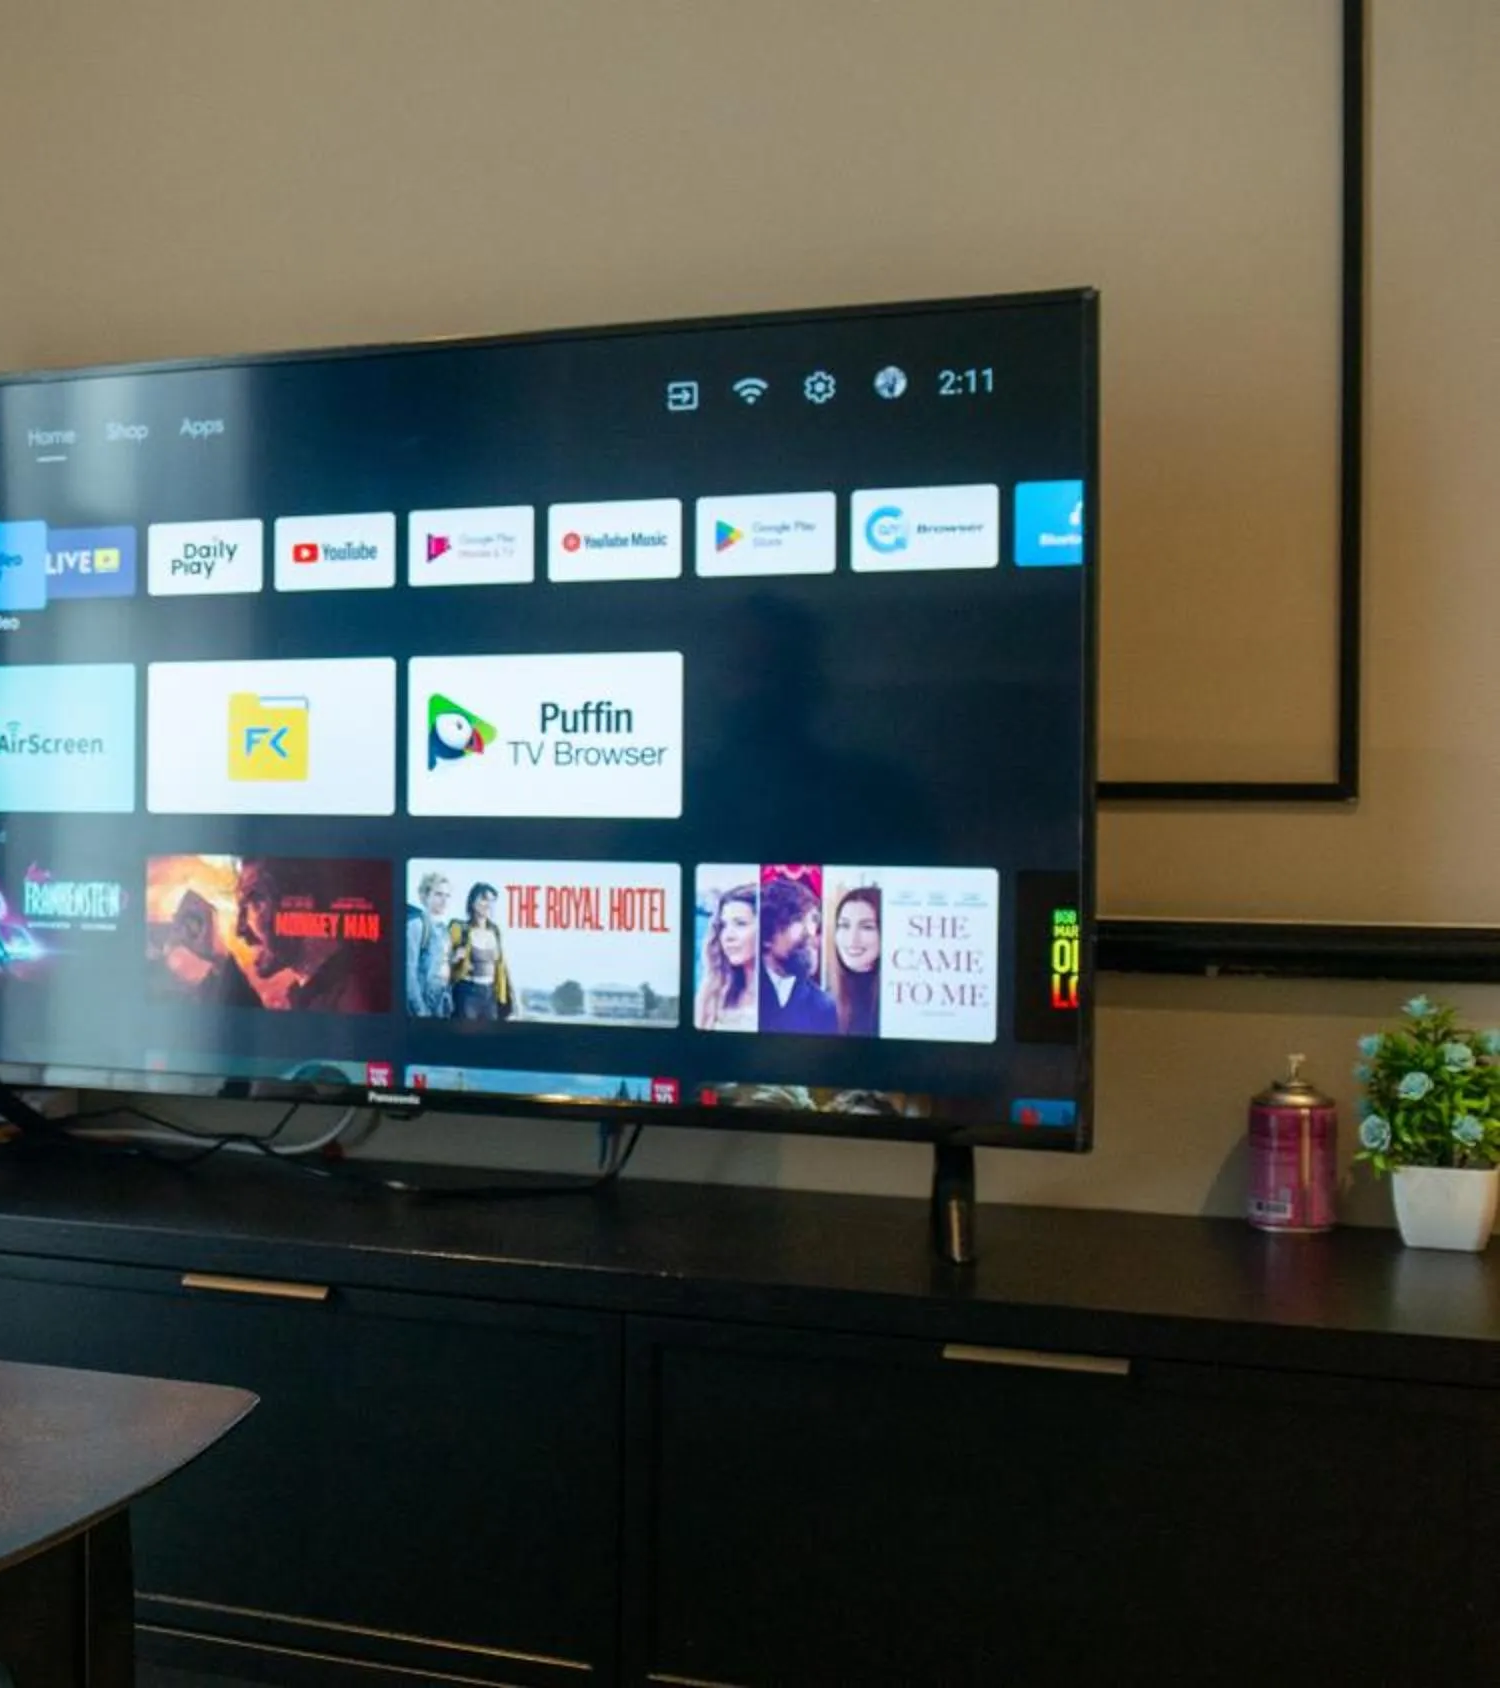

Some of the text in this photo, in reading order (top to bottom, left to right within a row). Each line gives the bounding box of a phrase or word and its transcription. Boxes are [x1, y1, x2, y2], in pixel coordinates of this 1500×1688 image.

[938, 367, 995, 396] 2:11
[28, 428, 76, 447] Home
[105, 421, 149, 443] Shop
[180, 416, 225, 439] Apps
[183, 538, 238, 562] Daily
[322, 542, 378, 562] YouTube
[584, 532, 668, 550] YouTube Music
[45, 550, 93, 575] LIVE
[171, 559, 216, 580] Play
[541, 701, 632, 734] Puffin
[508, 741, 667, 766] TV Browser
[505, 885, 669, 932] THE ROYAL HOTEL
[908, 914, 972, 939] SHE
[891, 948, 983, 974] CAME
[891, 981, 989, 1008] TO ME
